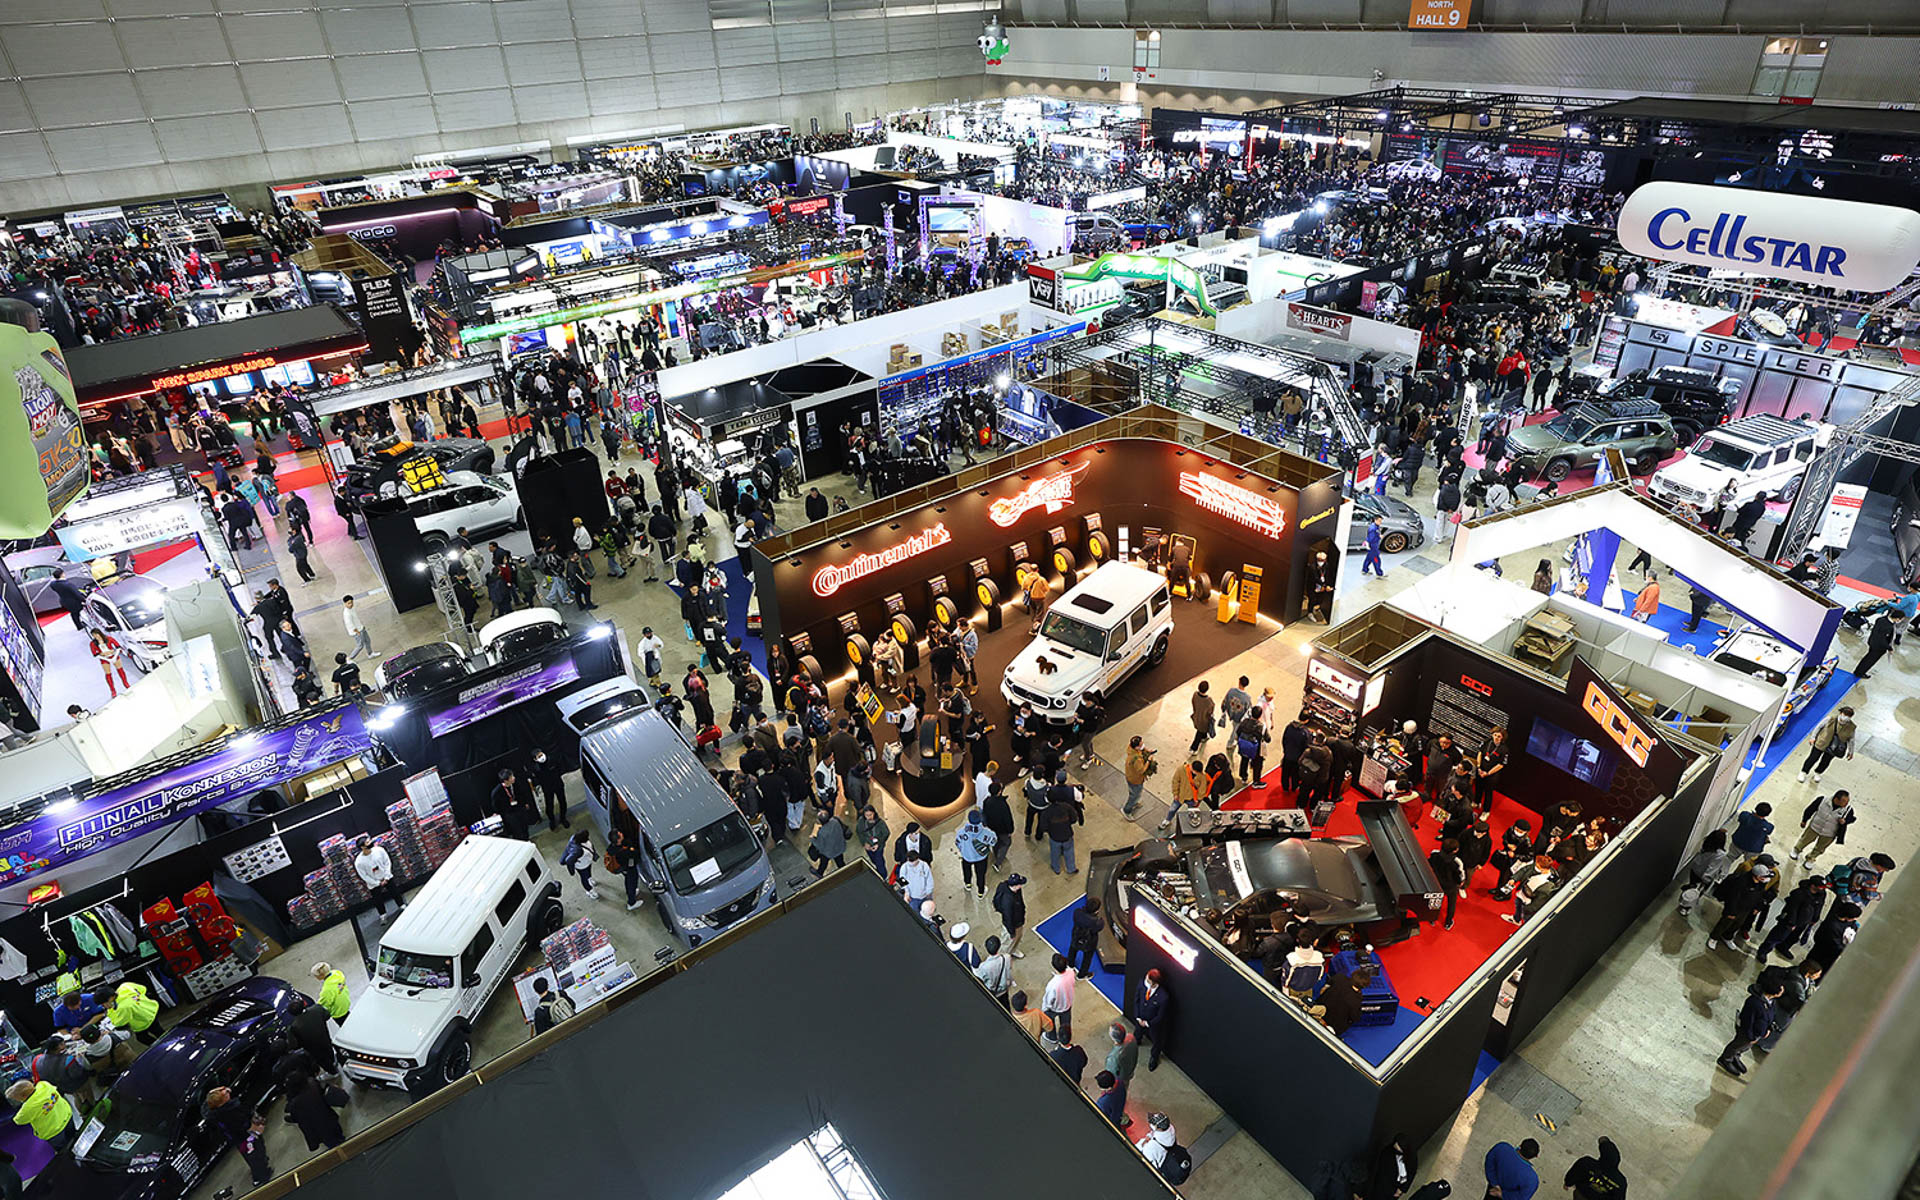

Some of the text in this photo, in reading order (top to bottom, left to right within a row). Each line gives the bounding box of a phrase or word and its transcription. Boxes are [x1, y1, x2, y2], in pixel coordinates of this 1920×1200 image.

[1427, 0, 1454, 9] NORTH
[1416, 10, 1461, 26] HALL 9
[1135, 72, 1143, 82] 9
[347, 224, 398, 240] NOCO
[361, 278, 392, 291] FLEX
[1303, 310, 1345, 331] HEARTS
[186, 365, 232, 383] SPARK
[231, 356, 276, 374] PLUGS
[26, 389, 53, 416] LIQUI
[33, 404, 56, 430] MOLY
[730, 420, 751, 430] TOP
[812, 529, 935, 597] Continental
[1460, 674, 1494, 697] GCG
[1581, 680, 1653, 768] GCG
[60, 793, 164, 845] FINAL
[165, 752, 279, 805] KONNEXION
